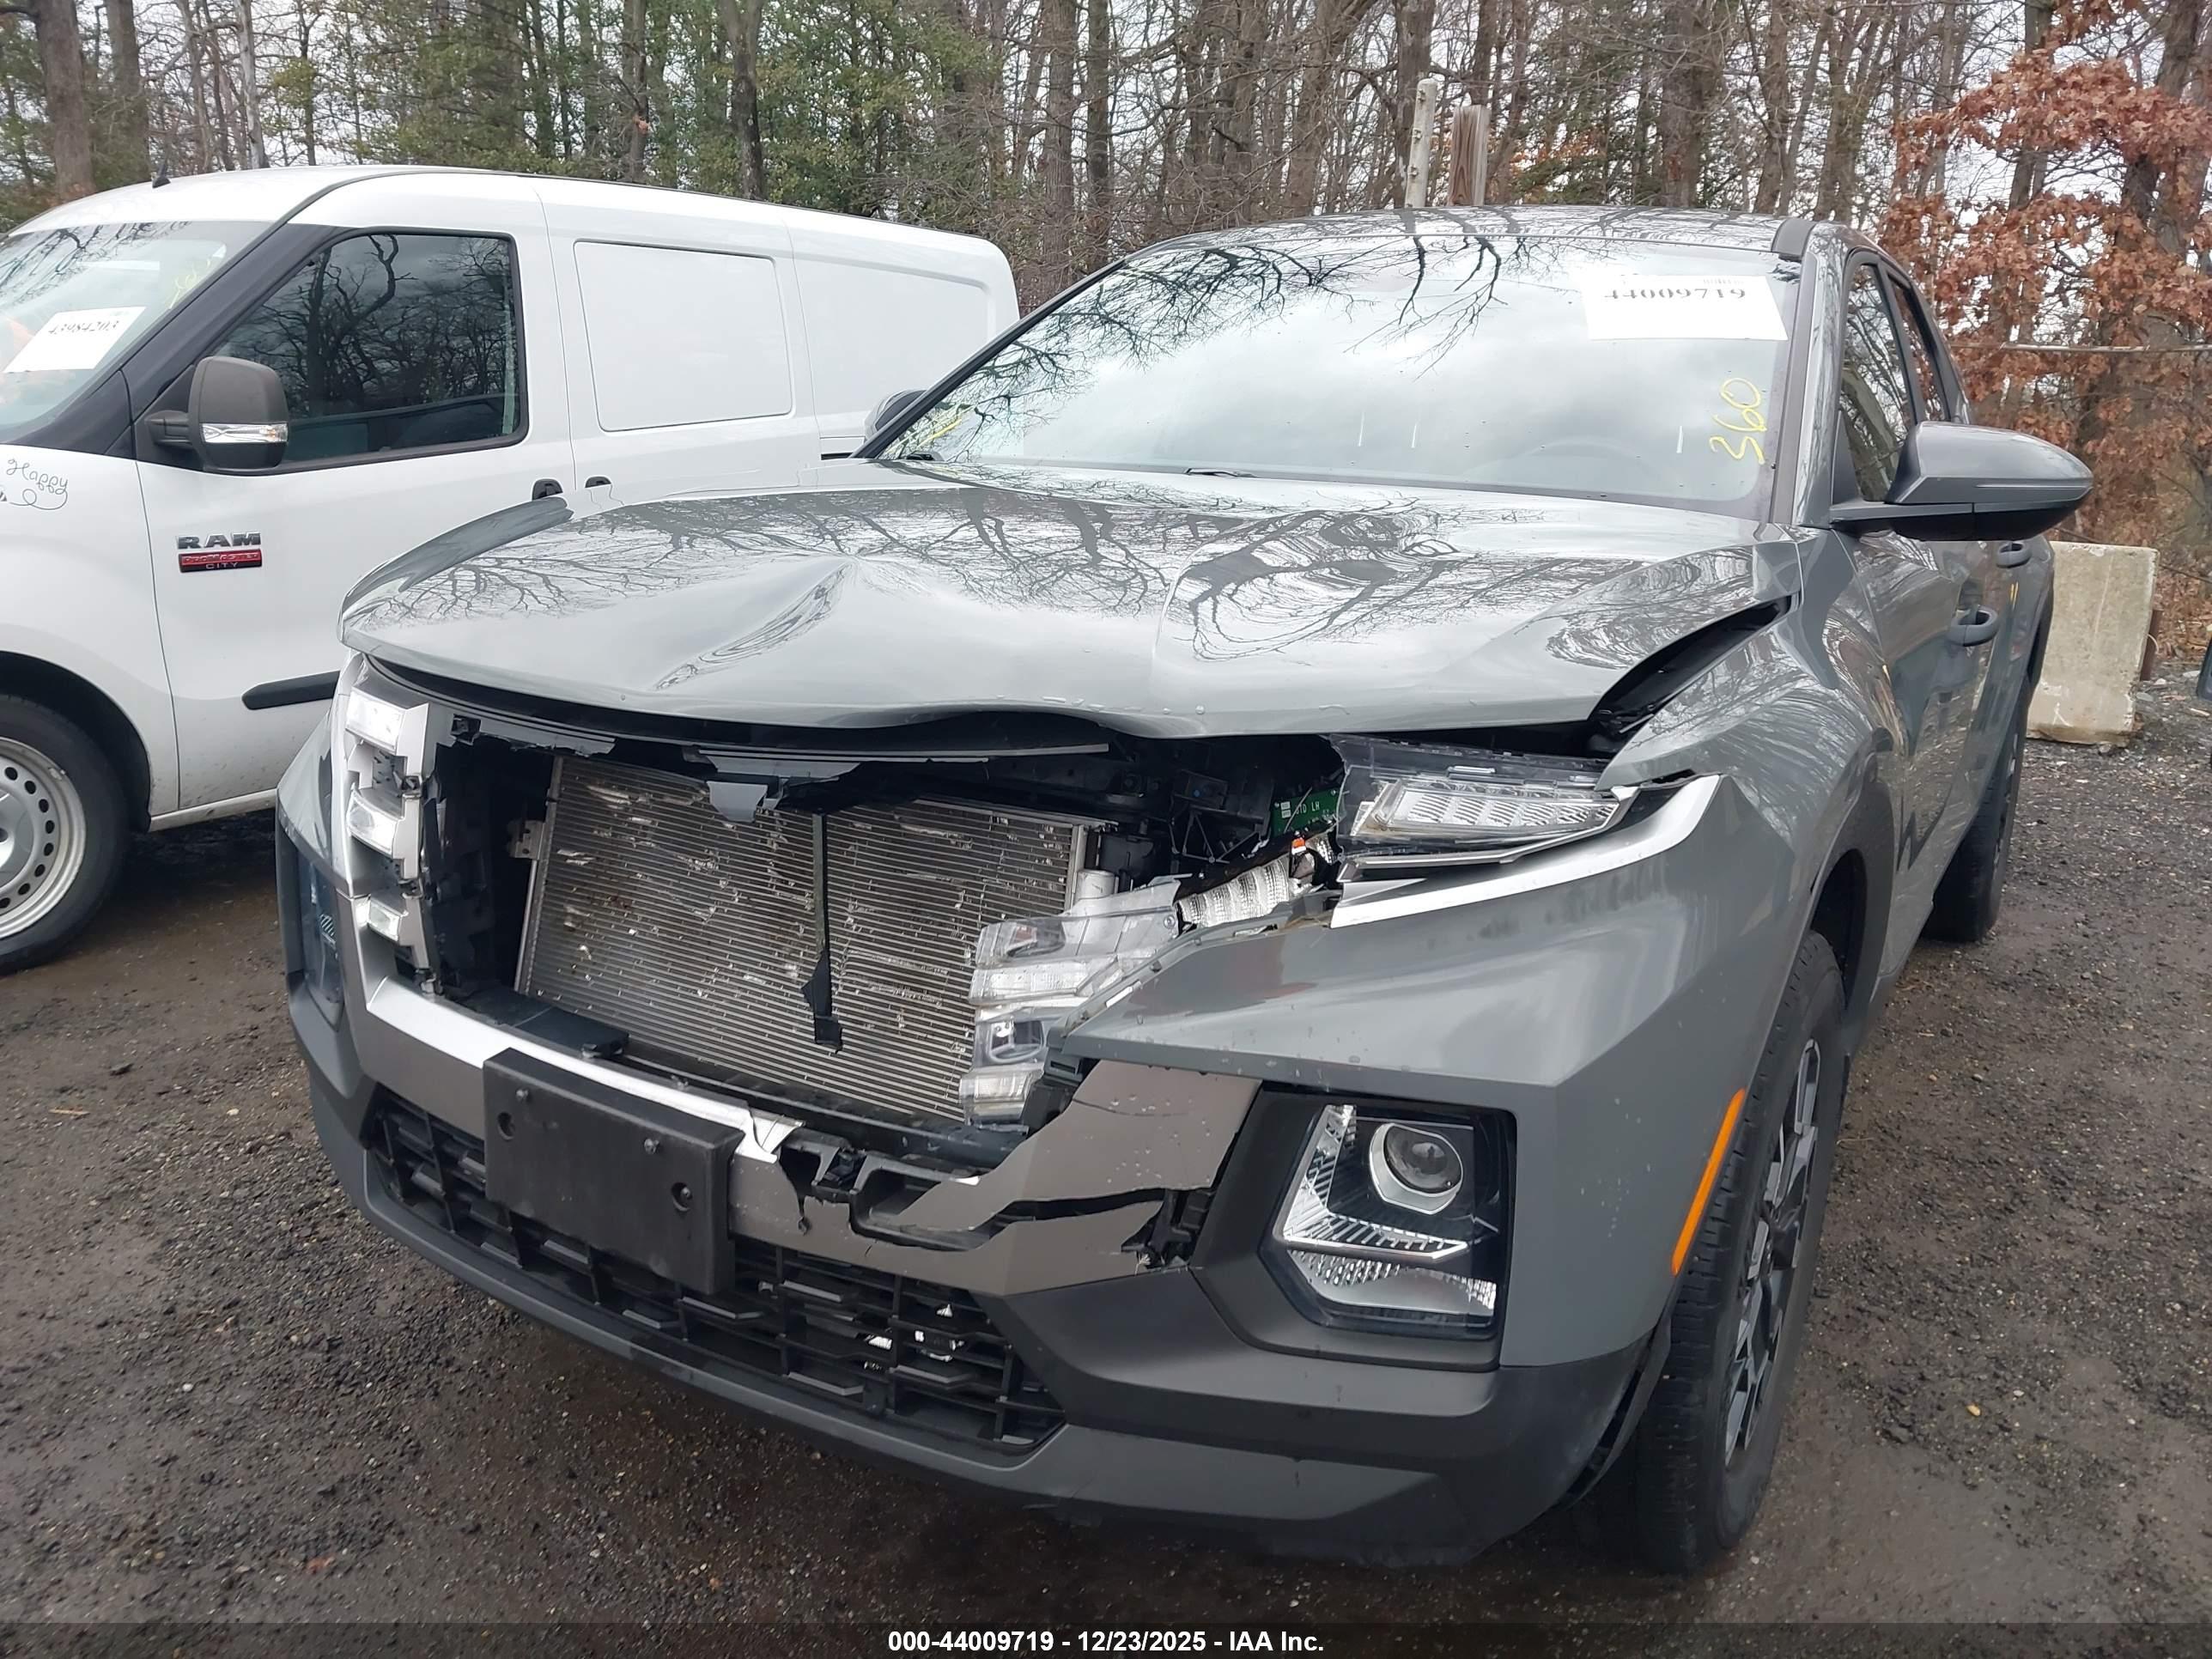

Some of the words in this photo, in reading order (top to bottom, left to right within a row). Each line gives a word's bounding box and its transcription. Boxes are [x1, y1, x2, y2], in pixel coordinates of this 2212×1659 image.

[1604, 288, 1746, 300] 44009719
[1709, 377, 1768, 465] 360
[6, 458, 69, 495] Happy
[177, 532, 261, 550] RAM
[1311, 801, 1320, 811] LH
